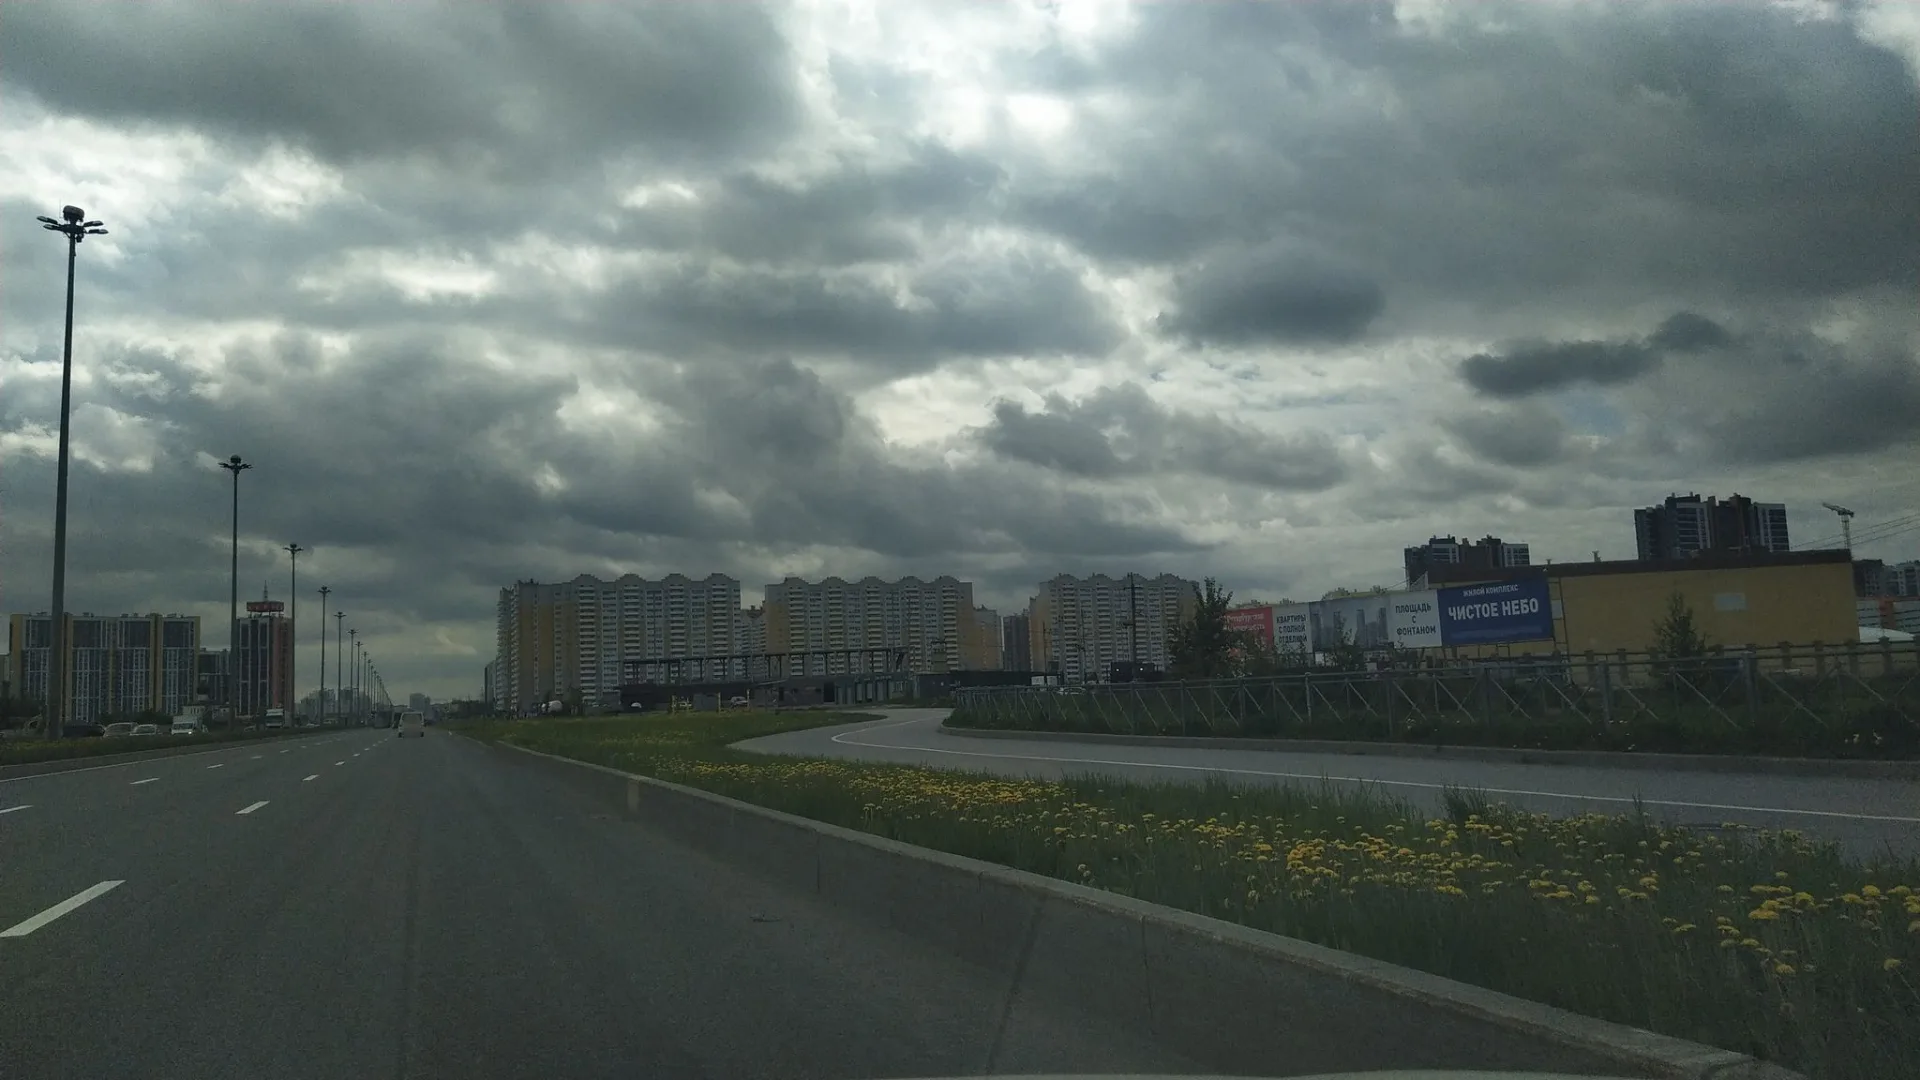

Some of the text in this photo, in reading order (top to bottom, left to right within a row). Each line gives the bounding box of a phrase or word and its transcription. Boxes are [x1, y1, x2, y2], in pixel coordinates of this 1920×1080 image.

[1463, 584, 1519, 597] ЖИЛОЙ КОМПЛЕКС
[1395, 603, 1432, 614] ПЛОЩАДЬ
[1448, 598, 1539, 621] ЧИСТОЕ НЕБО
[1276, 614, 1306, 624] КВАРТИРЫ
[1396, 625, 1437, 636] ФОНТАНОМ
